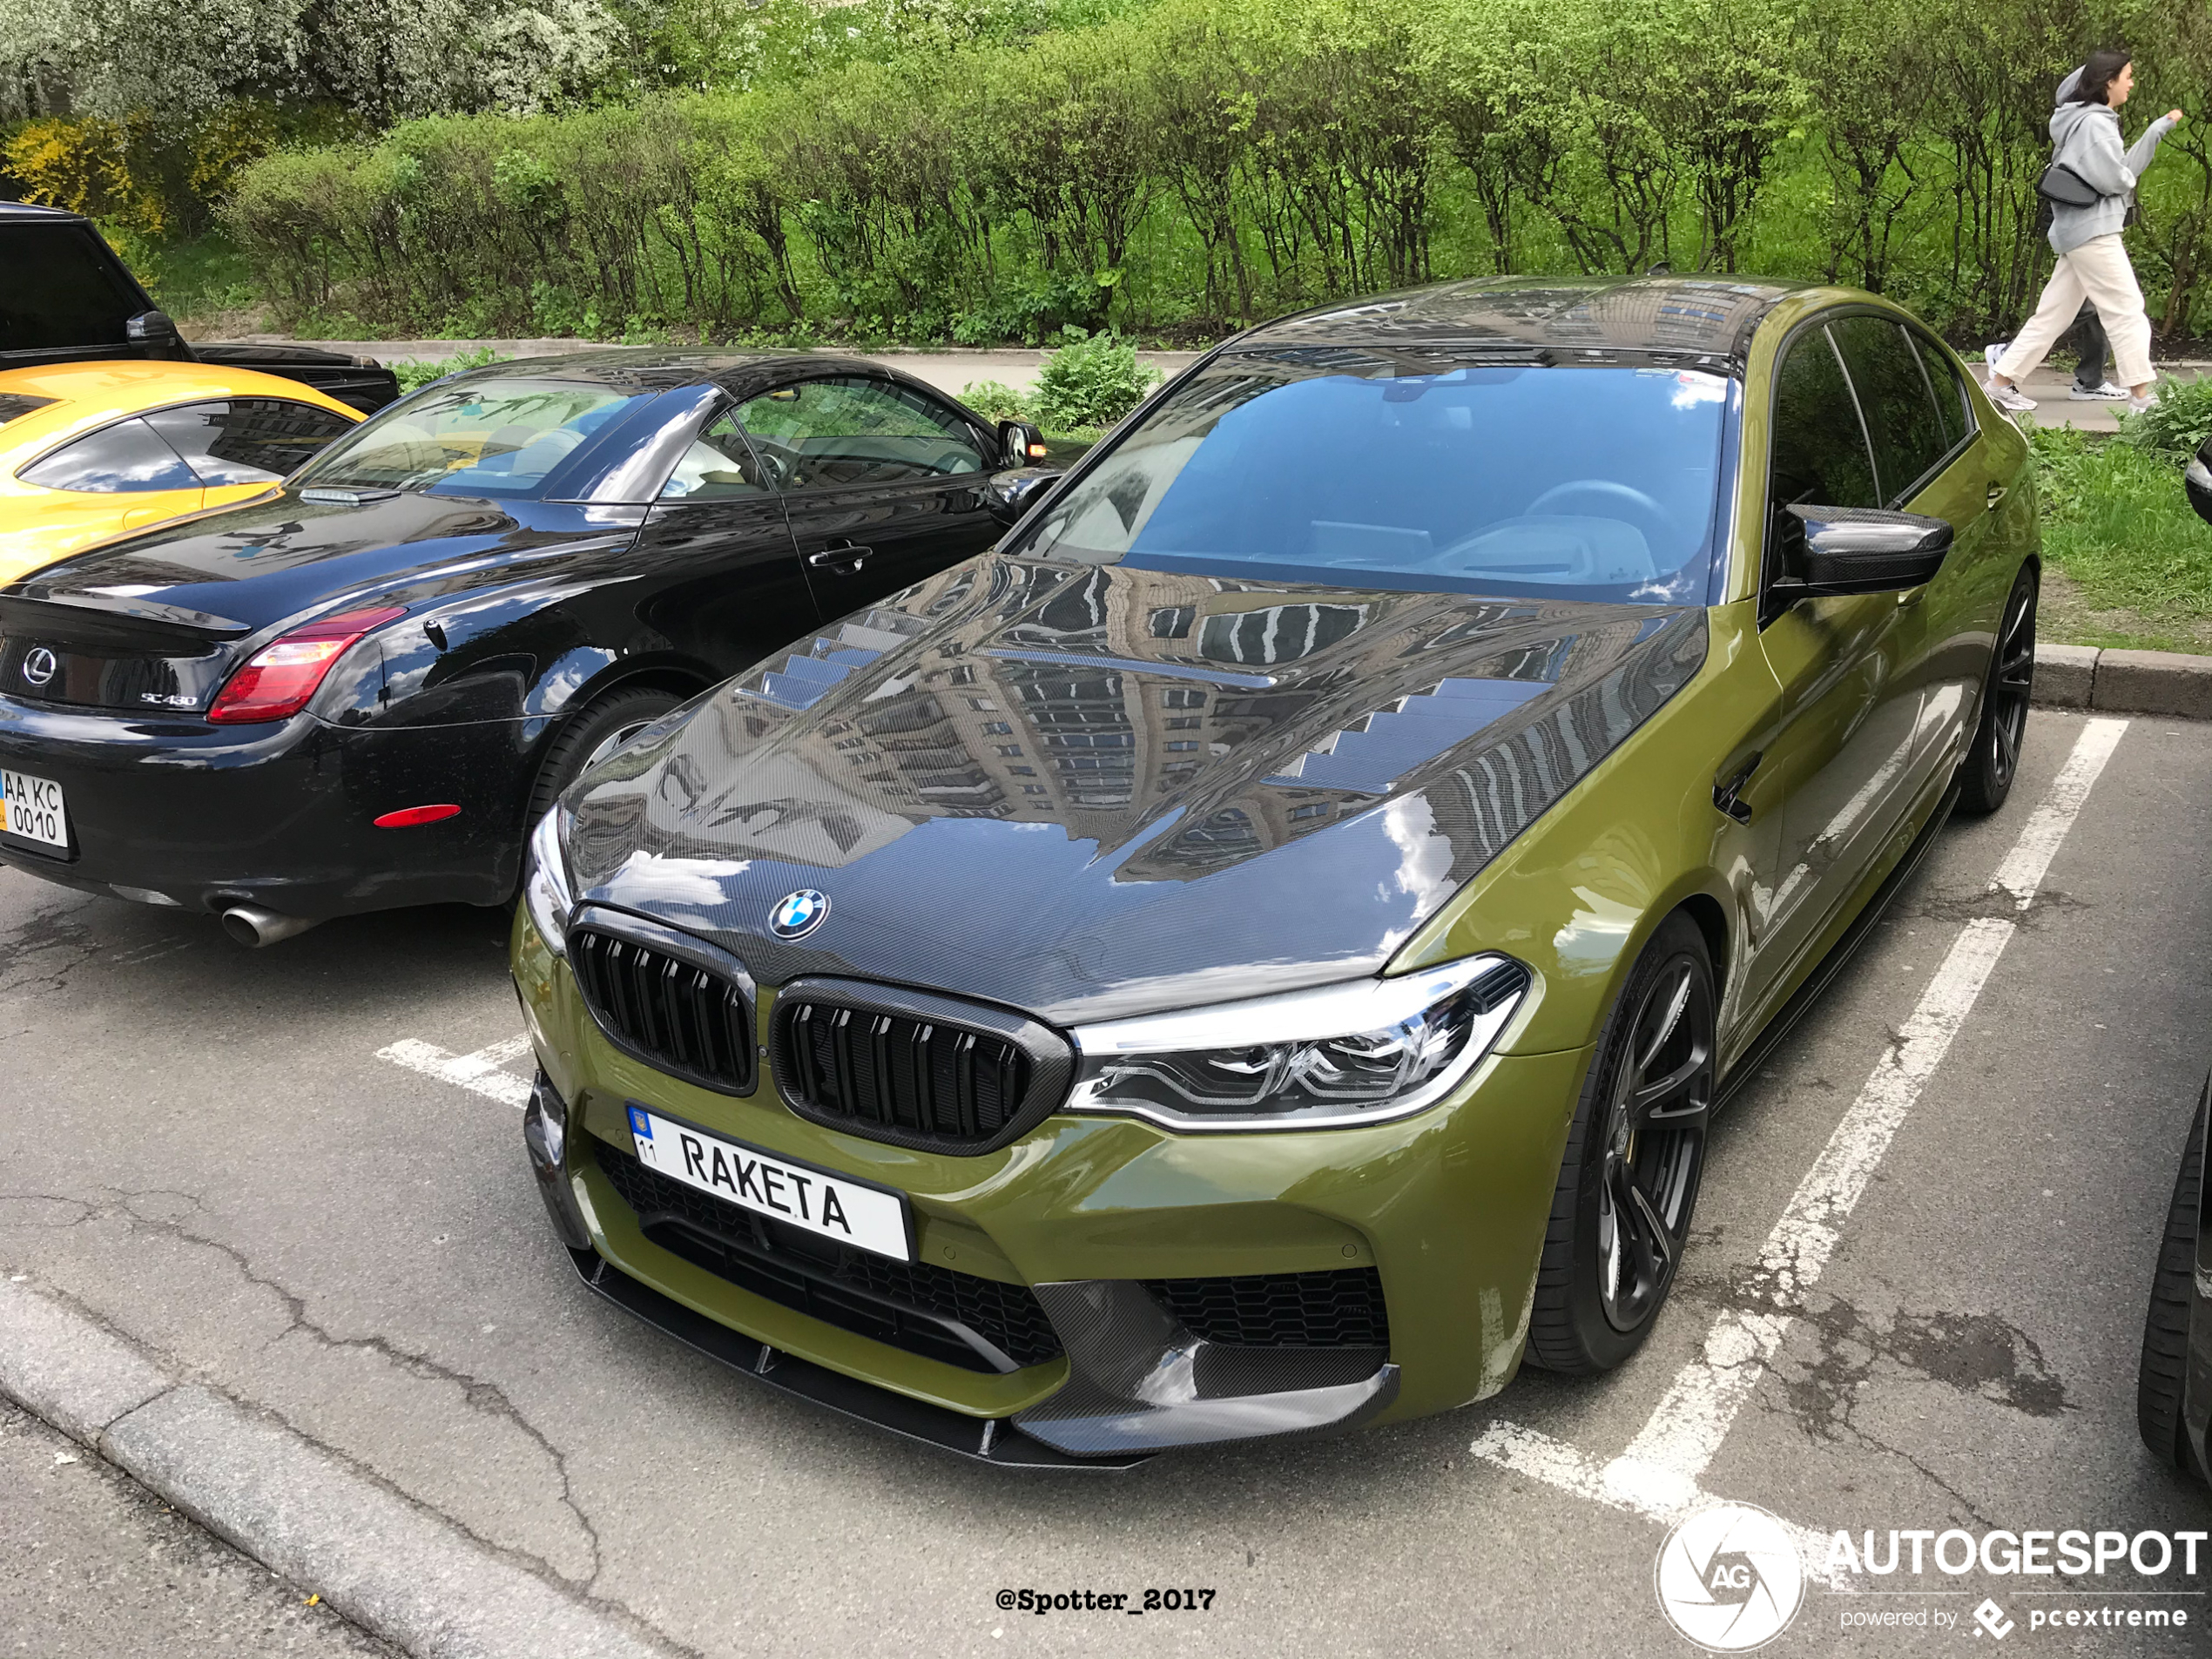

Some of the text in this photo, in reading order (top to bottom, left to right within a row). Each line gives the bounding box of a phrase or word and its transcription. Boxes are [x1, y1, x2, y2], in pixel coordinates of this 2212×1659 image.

[5, 772, 58, 812] AA KC
[14, 805, 57, 840] 0010
[639, 1139, 657, 1163] 11
[679, 1133, 853, 1235] RAKETA
